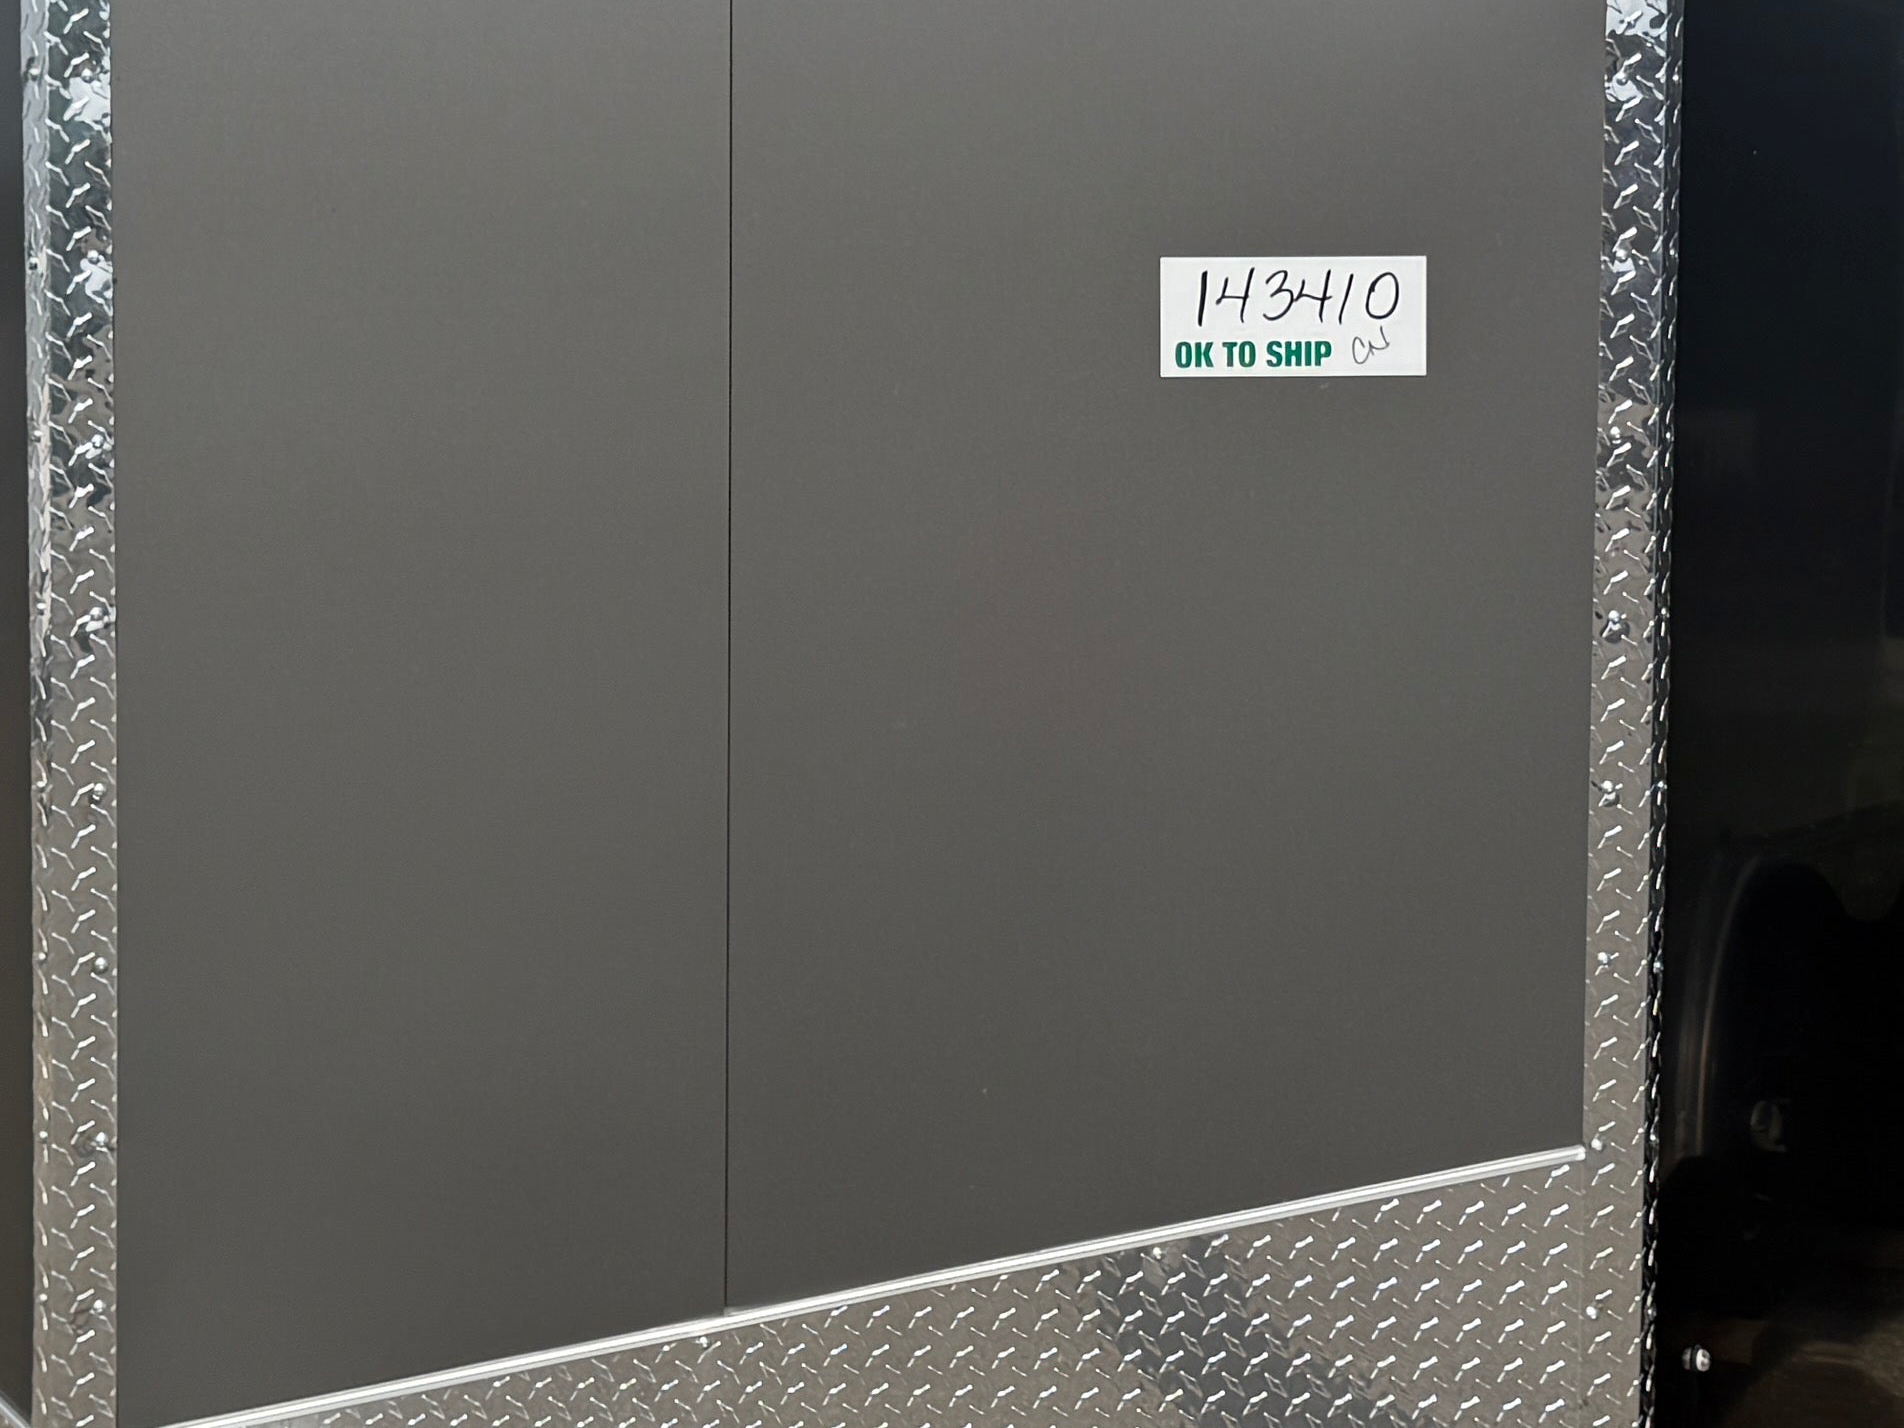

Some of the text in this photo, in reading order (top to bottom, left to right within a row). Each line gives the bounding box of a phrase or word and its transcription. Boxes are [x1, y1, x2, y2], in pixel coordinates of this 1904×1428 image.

[1198, 267, 1400, 326] 143410
[1175, 340, 1332, 368] OK TO SHIP
